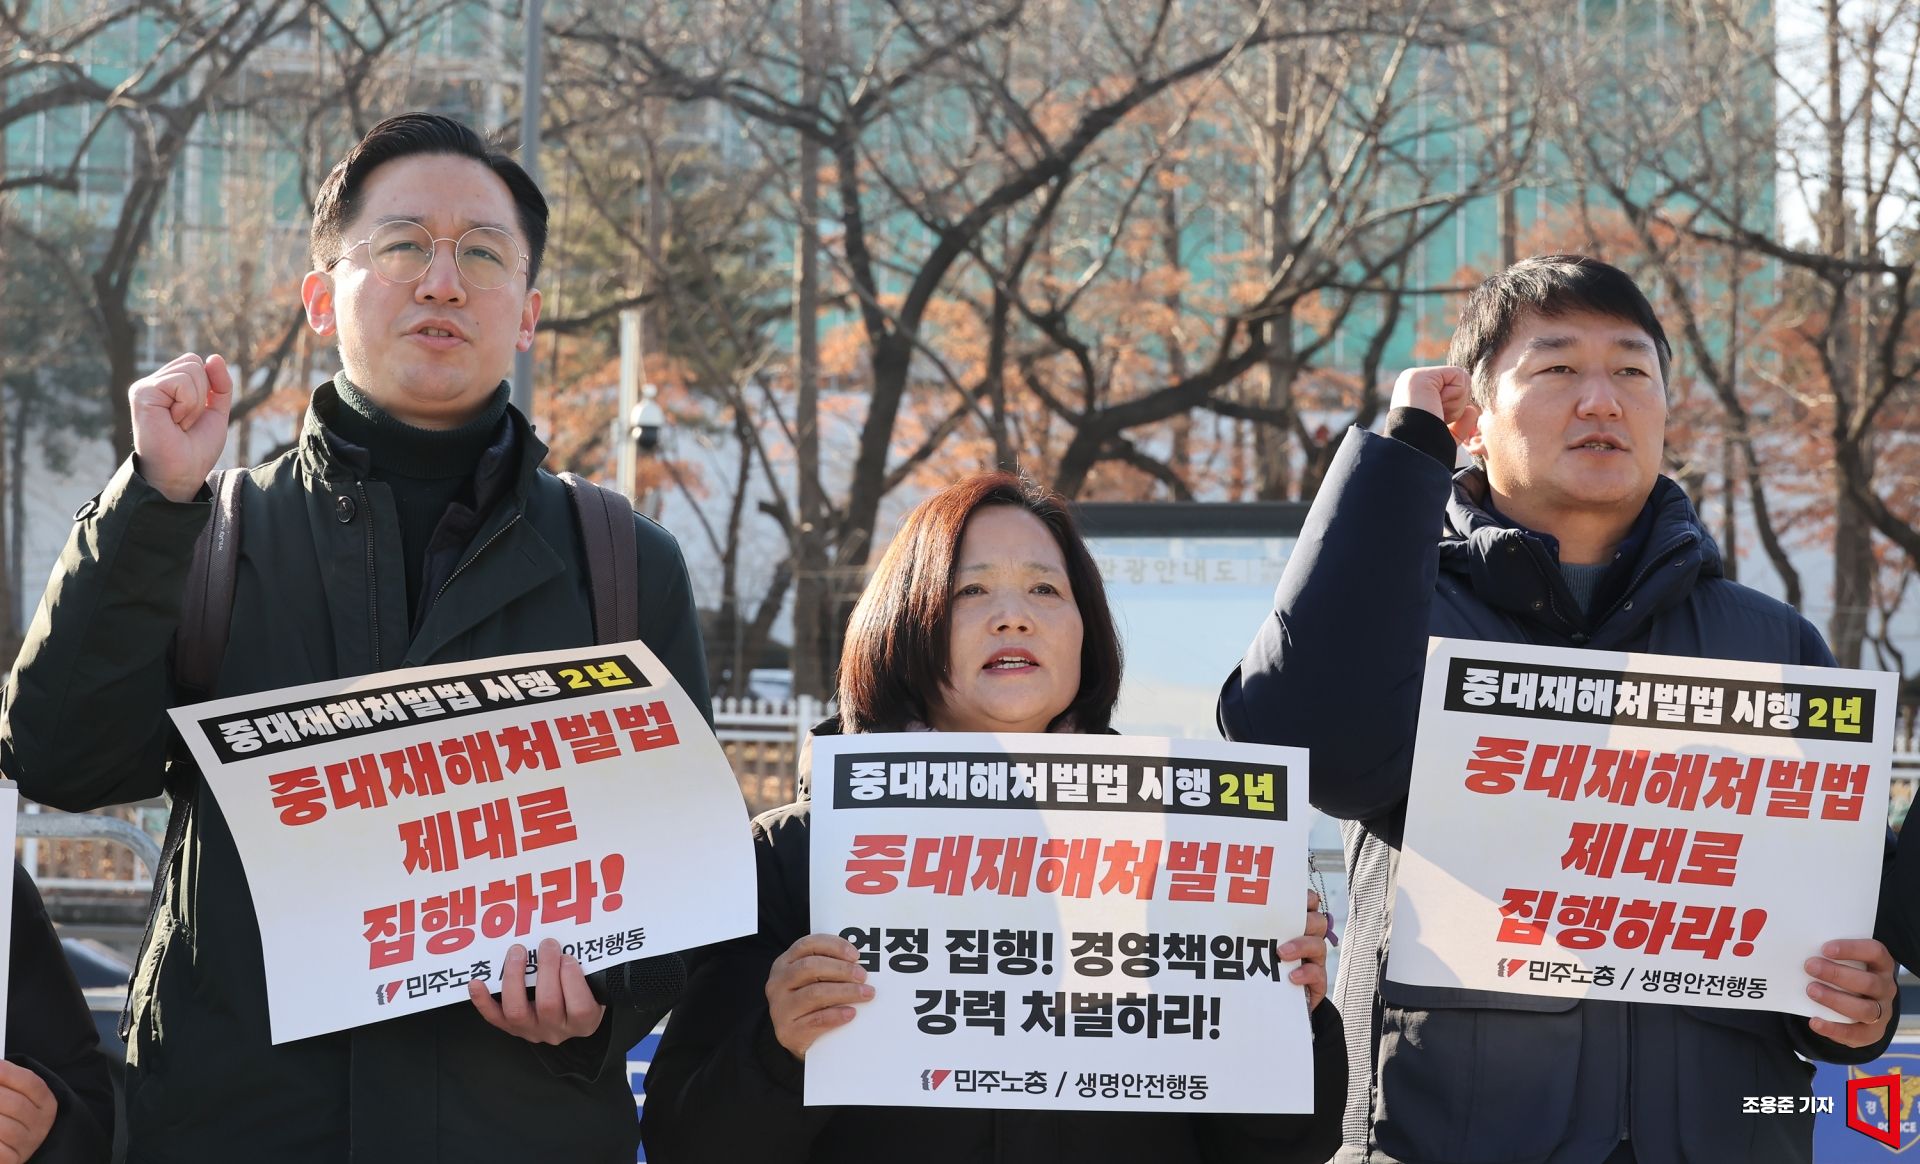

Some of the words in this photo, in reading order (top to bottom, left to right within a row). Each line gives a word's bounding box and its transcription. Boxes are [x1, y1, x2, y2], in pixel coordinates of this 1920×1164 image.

[217, 681, 477, 753] 중대재해처벌법
[478, 669, 561, 702] 시행
[558, 661, 632, 689] 2년
[1462, 667, 1724, 725] 중대재해처벌법
[1731, 690, 1801, 730] 시행
[1808, 697, 1862, 734] 2년
[269, 701, 679, 826] 중대재해처벌법
[850, 761, 1128, 803] 중대재해처벌법
[1138, 766, 1211, 807] 시행
[1219, 773, 1275, 812] 2년
[1465, 736, 1870, 821] 중대재해처벌법
[398, 786, 578, 875] 제대로
[1561, 823, 1743, 887] 제대로
[845, 834, 1274, 905] 중대재해처벌법
[363, 853, 625, 969] 집행하라!
[1496, 888, 1767, 960] 집행하라!
[407, 960, 491, 998] 민주노총
[839, 926, 929, 974] 엄정
[945, 929, 1053, 975] 집행!
[1070, 932, 1281, 982] 경영책임자
[1528, 960, 1615, 987] 민주노총
[1639, 969, 1768, 999] 생명안전행동
[914, 990, 1006, 1036] 강력
[1021, 991, 1221, 1040] 처벌하라!
[955, 1069, 1048, 1095] 민주노총
[1075, 1073, 1209, 1100] 생명안전행동
